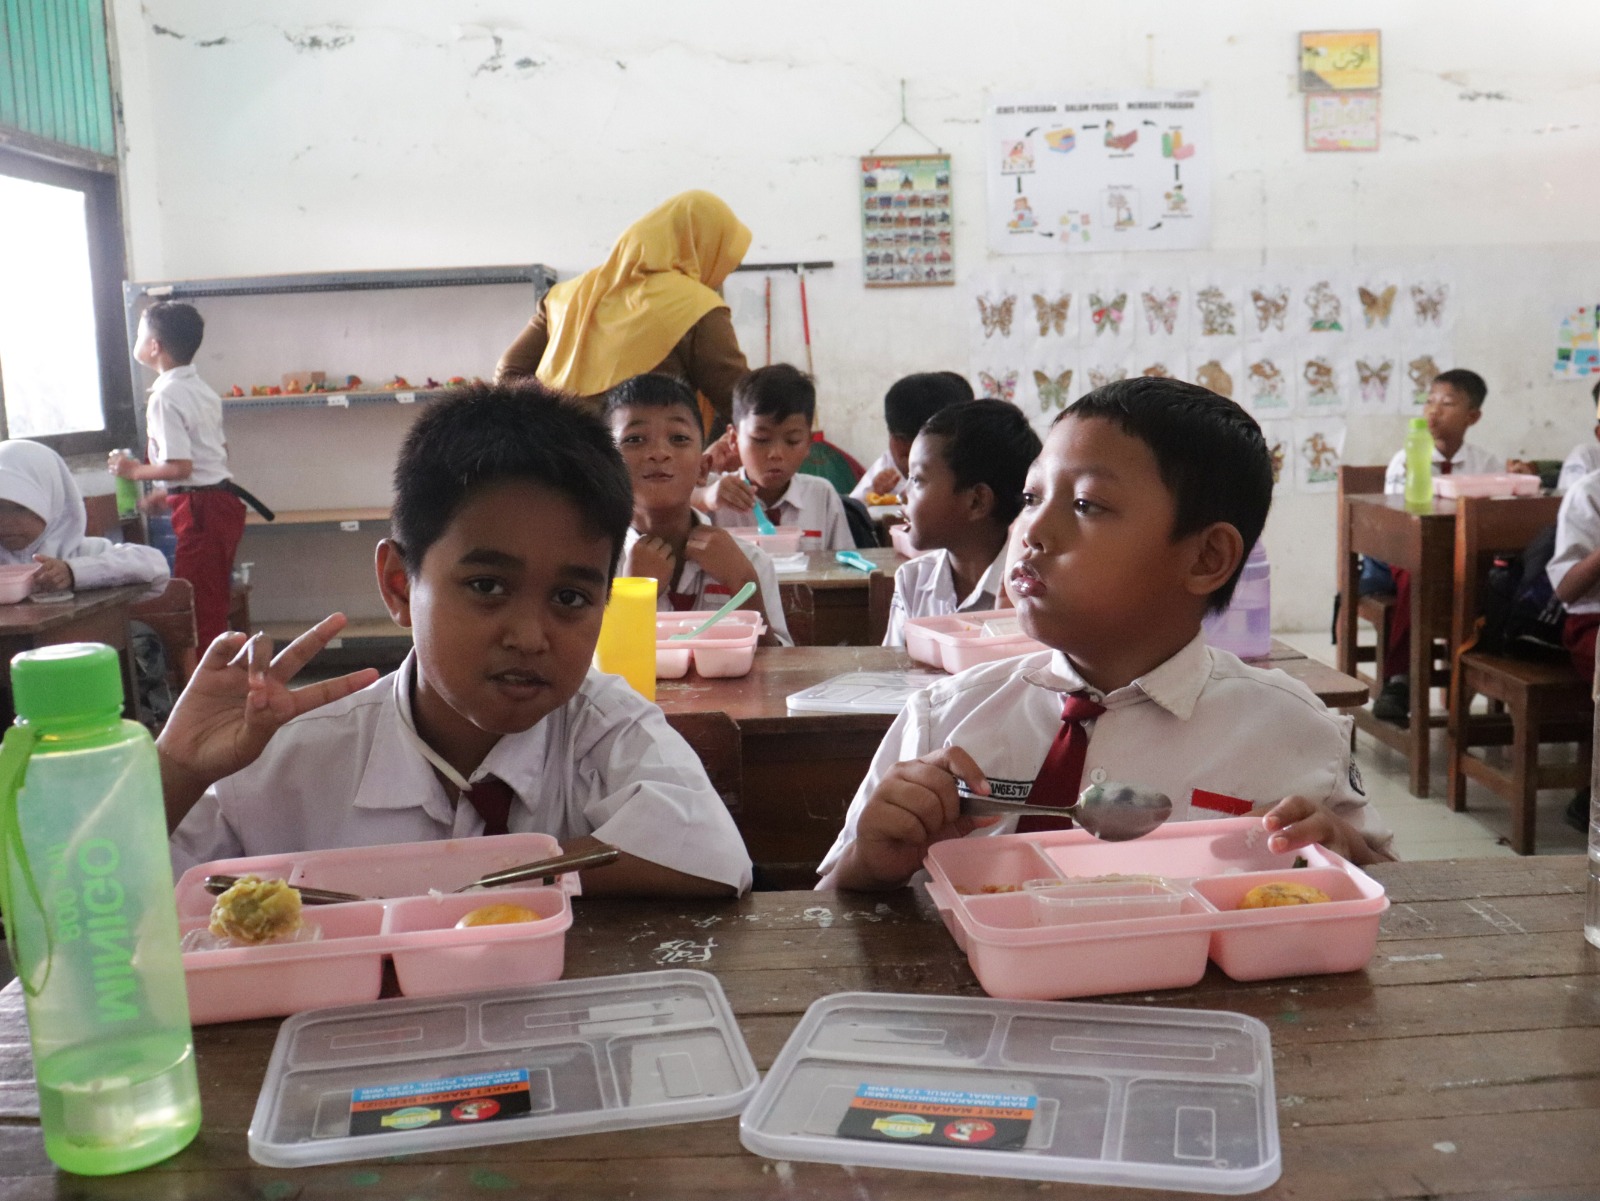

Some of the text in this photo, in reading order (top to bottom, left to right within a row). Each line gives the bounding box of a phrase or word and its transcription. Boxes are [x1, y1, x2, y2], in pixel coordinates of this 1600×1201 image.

[988, 782, 1029, 796] ANGESTU
[462, 1071, 520, 1082] MAKSIMAL
[493, 1077, 520, 1085] BAIK
[420, 1079, 457, 1088] PUKUL
[361, 1084, 519, 1109] PAKET MAKAN BERGIZI
[925, 1089, 964, 1098] PUKUL
[968, 1092, 1029, 1102] MAKSIMAL
[862, 1099, 1023, 1117] PAKET MAKAN BERGIZI
